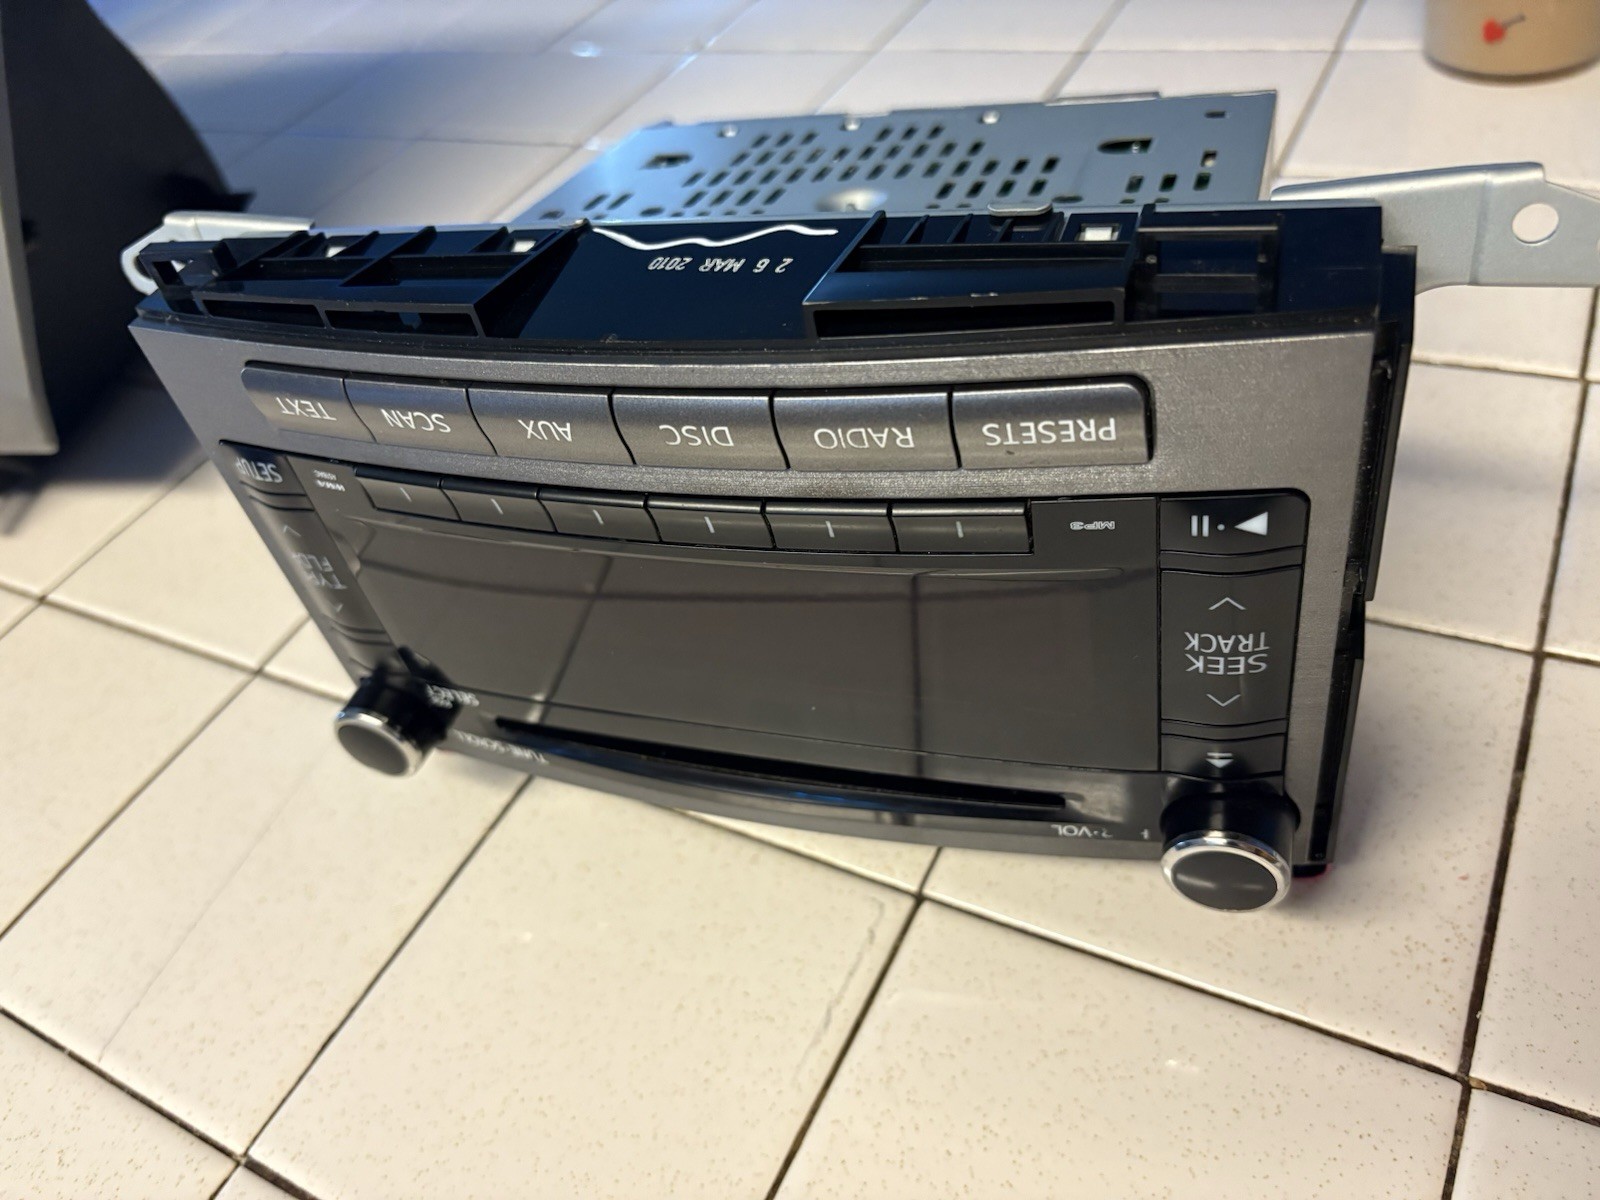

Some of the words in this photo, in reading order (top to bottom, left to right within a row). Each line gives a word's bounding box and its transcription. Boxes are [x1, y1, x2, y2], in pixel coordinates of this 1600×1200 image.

[648, 256, 693, 271] 2010
[699, 257, 746, 273] MAR
[274, 396, 336, 421] TEXT
[381, 408, 451, 433] SCAN
[517, 419, 572, 442] AUX
[982, 418, 1117, 445] PRESETS
[659, 424, 734, 447] DISC
[814, 426, 914, 449] RADIO
[235, 457, 283, 484] SETUP
[1070, 519, 1115, 531] MP3
[1184, 632, 1270, 654] TRACK
[1185, 653, 1268, 675] SEEK
